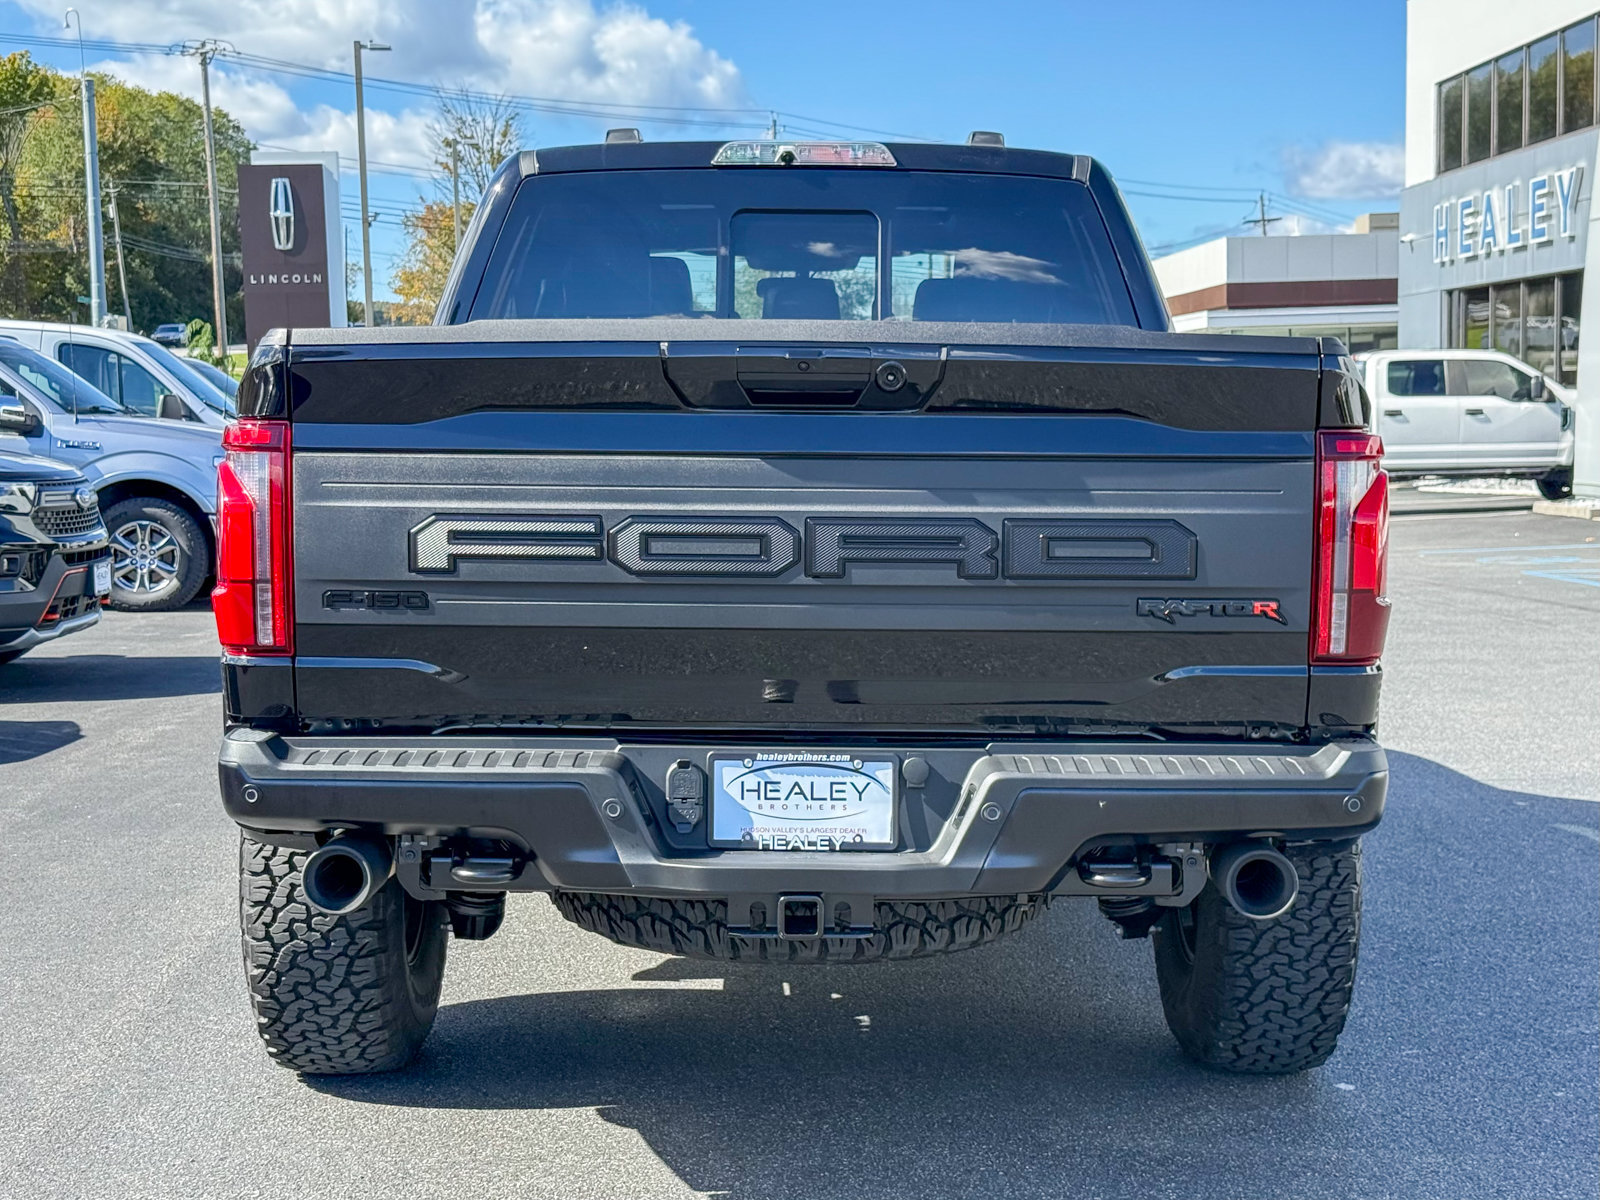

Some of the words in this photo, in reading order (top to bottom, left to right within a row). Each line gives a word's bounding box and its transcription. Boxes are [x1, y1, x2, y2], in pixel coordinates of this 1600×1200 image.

[1433, 167, 1583, 264] HEALEY
[250, 274, 322, 284] LINCOLN
[408, 512, 1198, 579] FORD
[322, 589, 429, 610] F-150
[1136, 597, 1288, 625] RAPTOR
[756, 752, 851, 762] healeybrothers.com
[741, 780, 871, 801] HEALEY
[758, 803, 848, 811] BROTHERS
[758, 834, 847, 851] HEALEY
